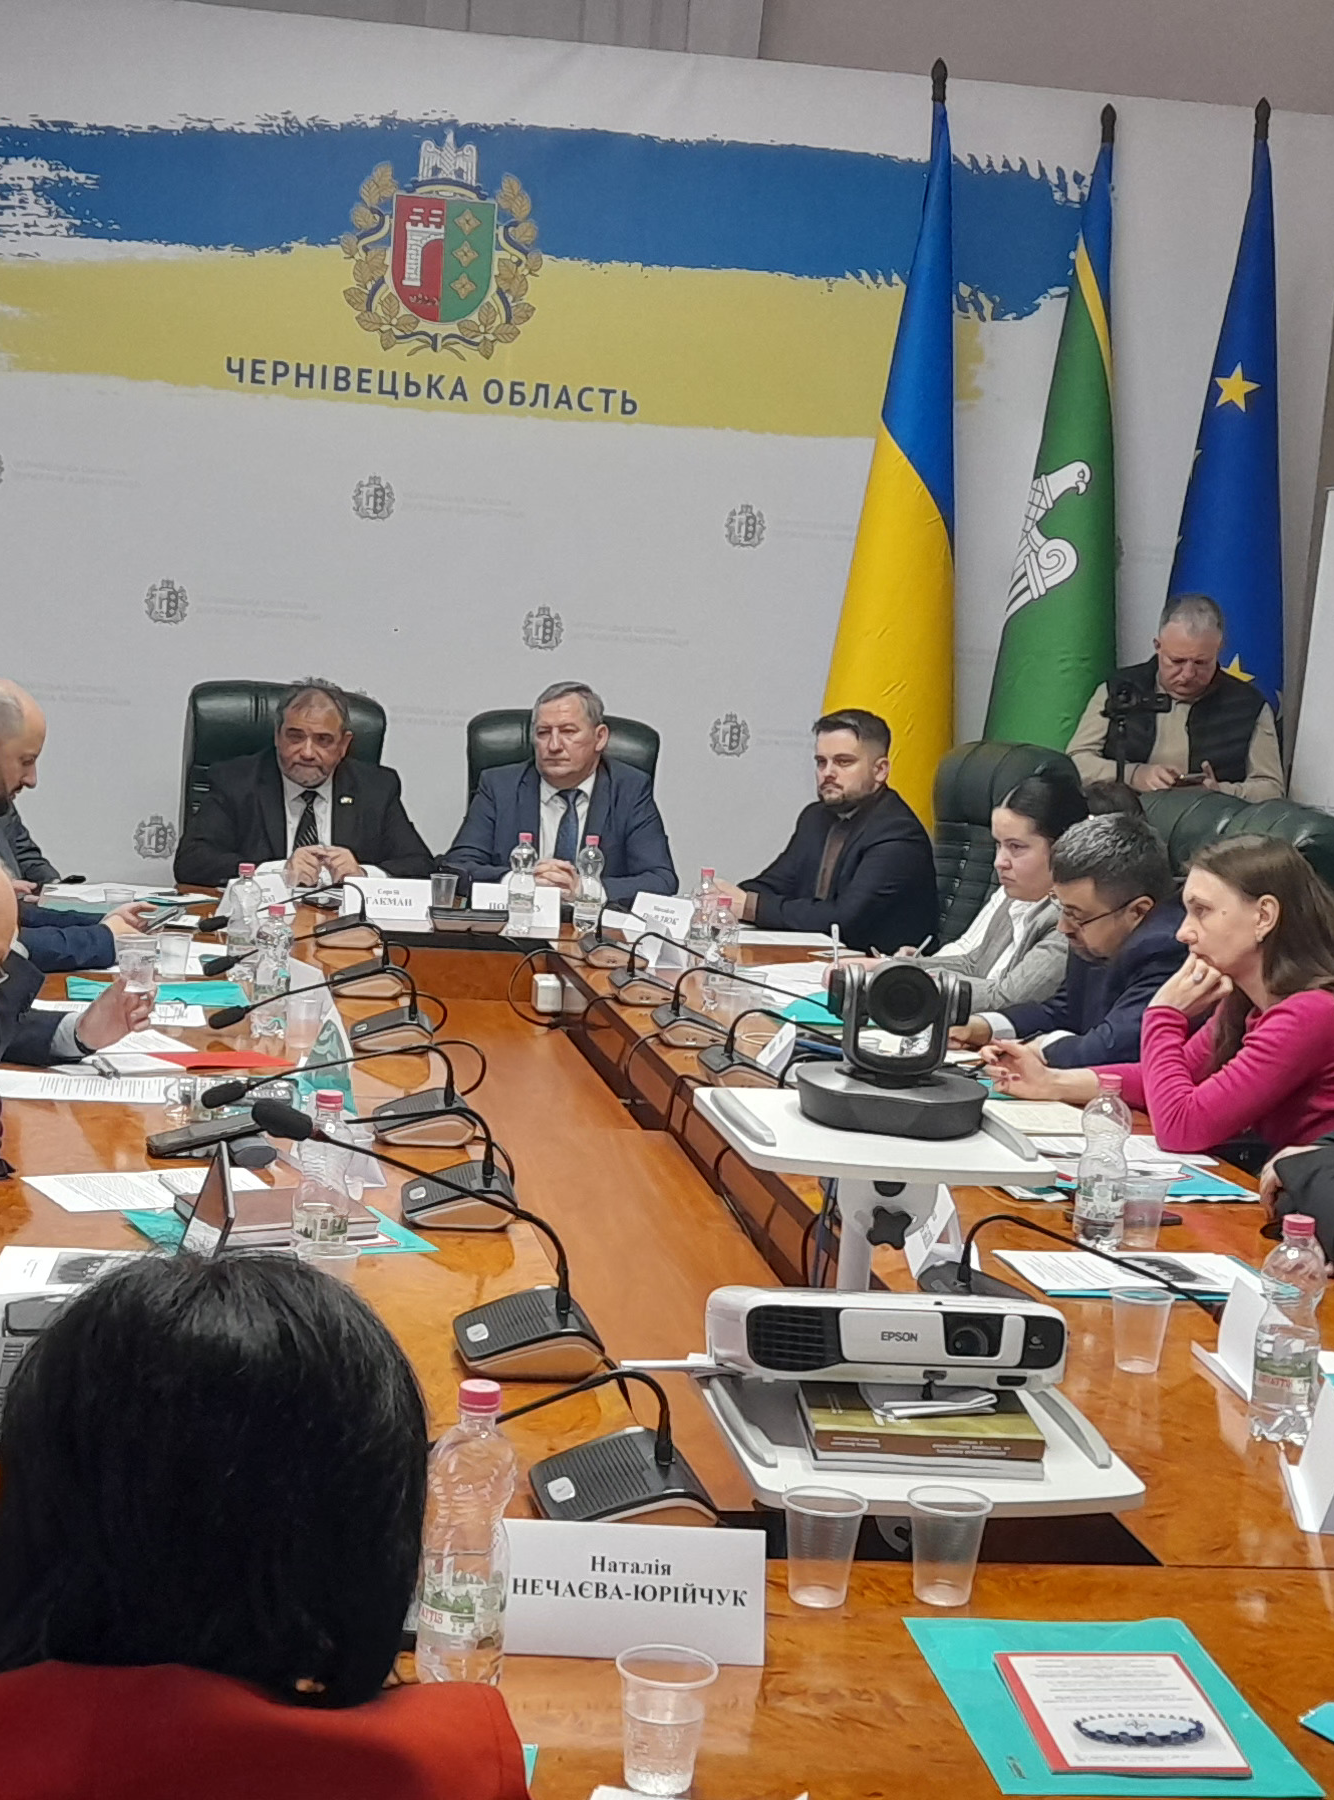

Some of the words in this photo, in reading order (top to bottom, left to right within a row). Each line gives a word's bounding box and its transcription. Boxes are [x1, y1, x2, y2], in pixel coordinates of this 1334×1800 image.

[225, 356, 469, 402] ЧЕРНІВЕЦЬКА
[482, 378, 639, 416] ОБЛАСТЬ
[880, 1331, 918, 1342] EPSON
[590, 1554, 672, 1577] Наталія
[511, 1577, 748, 1607] НЕЧАЄВА-ЮРІЙЧУК
